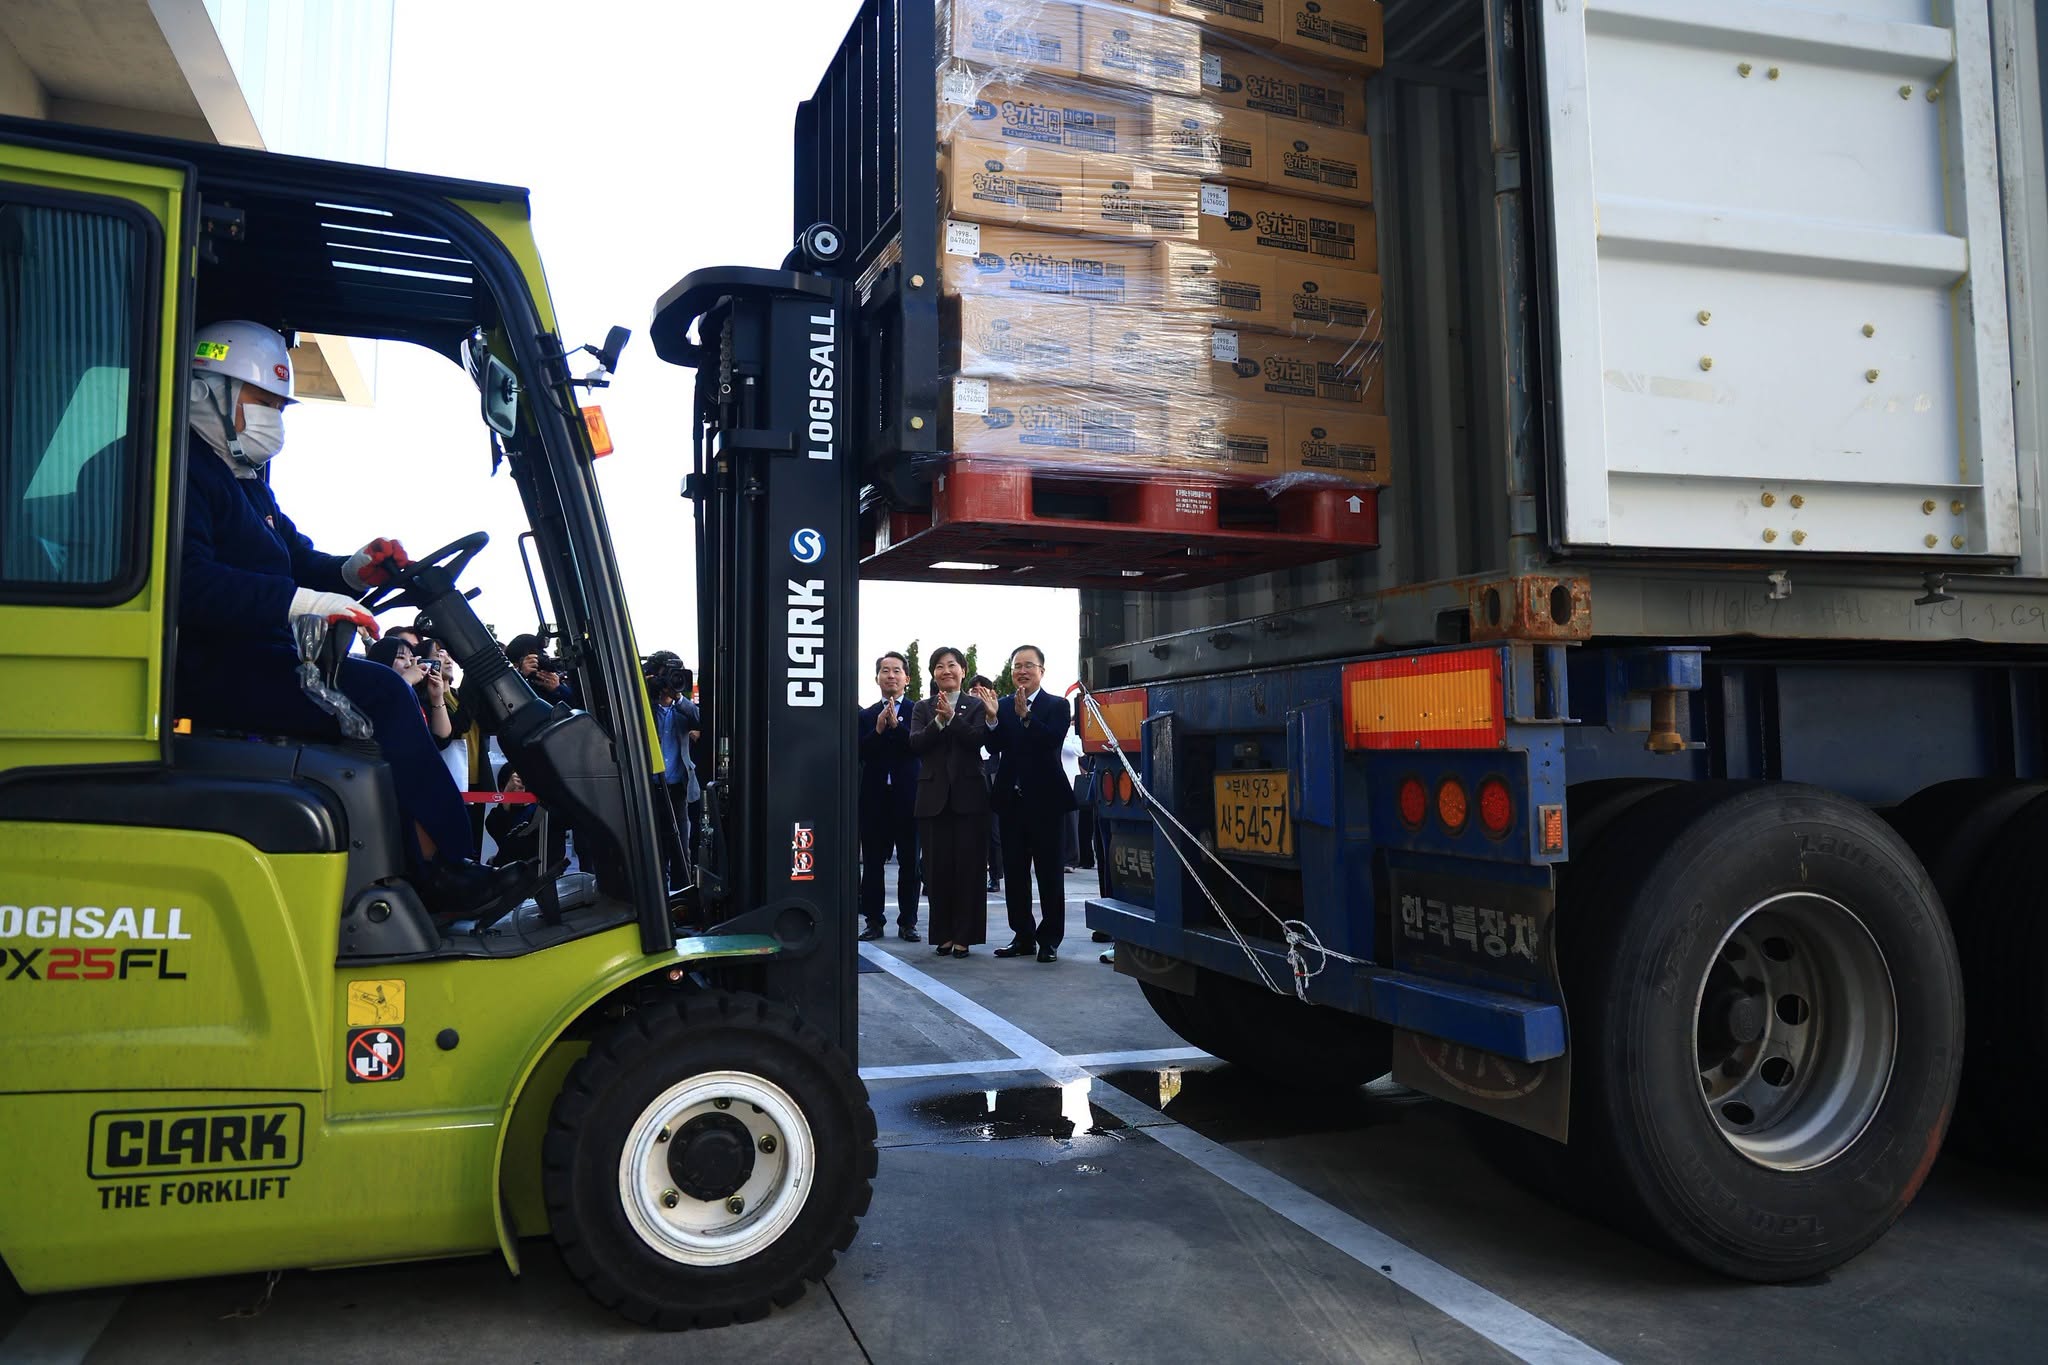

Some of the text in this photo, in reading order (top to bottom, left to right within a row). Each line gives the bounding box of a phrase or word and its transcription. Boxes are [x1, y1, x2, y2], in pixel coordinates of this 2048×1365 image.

[1230, 215, 1247, 226] 하림
[808, 309, 835, 460] LOGISALL
[787, 579, 825, 707] CLARK
[1115, 847, 1154, 879] 한국특
[1401, 894, 1540, 963] 한국특장차
[105, 1113, 288, 1168] CLARK
[98, 1176, 291, 1209] THE FORKLIFT
